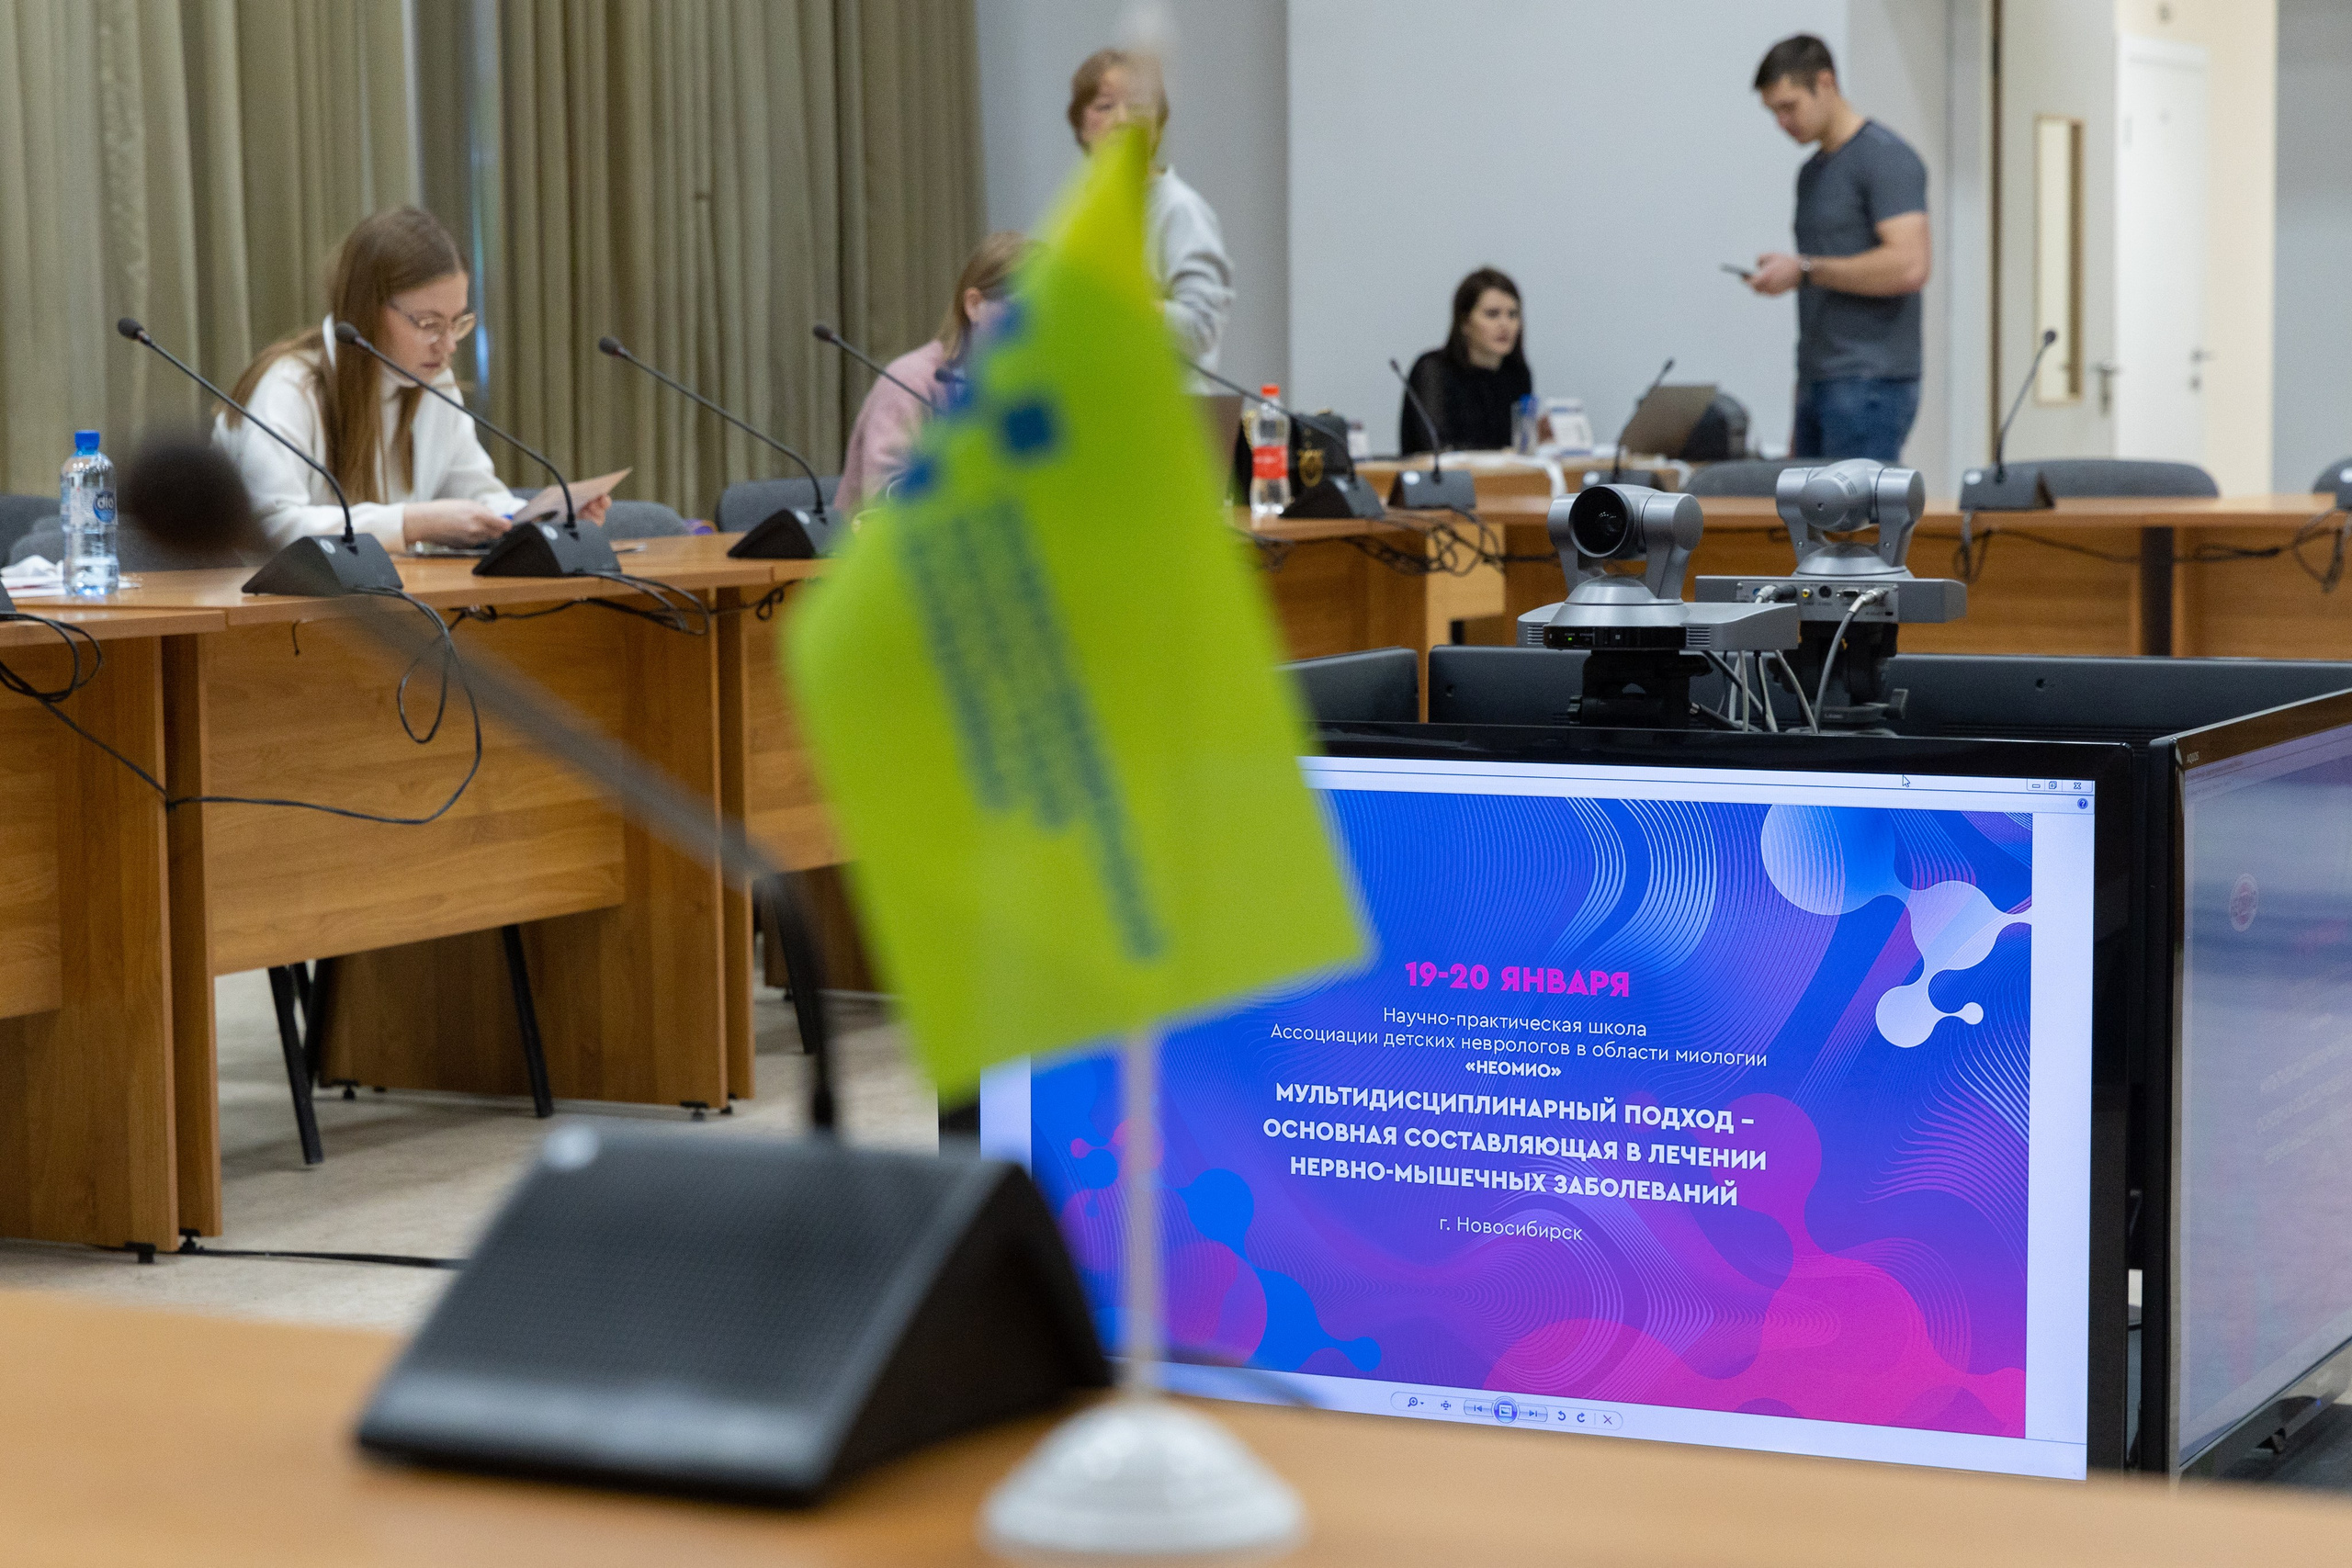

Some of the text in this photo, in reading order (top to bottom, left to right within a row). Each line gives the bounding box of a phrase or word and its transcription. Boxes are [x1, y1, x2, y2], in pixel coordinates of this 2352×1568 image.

[1405, 961, 1630, 998] 19-20 ЯНВАРЯ
[1383, 1007, 1647, 1037] Научно-практическая школа
[1271, 1022, 1768, 1067] Ассоциации детских неврологов в области миологии
[1464, 1059, 1562, 1078] «НЕОМИО»
[1275, 1082, 1617, 1123] МУЛЬТИДИСЦИПЛИНАРНЫЙ
[1624, 1104, 1735, 1134] ПОДХОД
[1262, 1118, 1767, 1170] ОСНОВНАЯ СОСТАВЛЯЮЩАЯ В ЛЕЧЕНИИ
[1290, 1156, 1738, 1206] НЕРВНО-МЫШЕЧНЫХ ЗАБОЛЕВАНИЙ
[1440, 1216, 1583, 1242] г. Новосибирск
